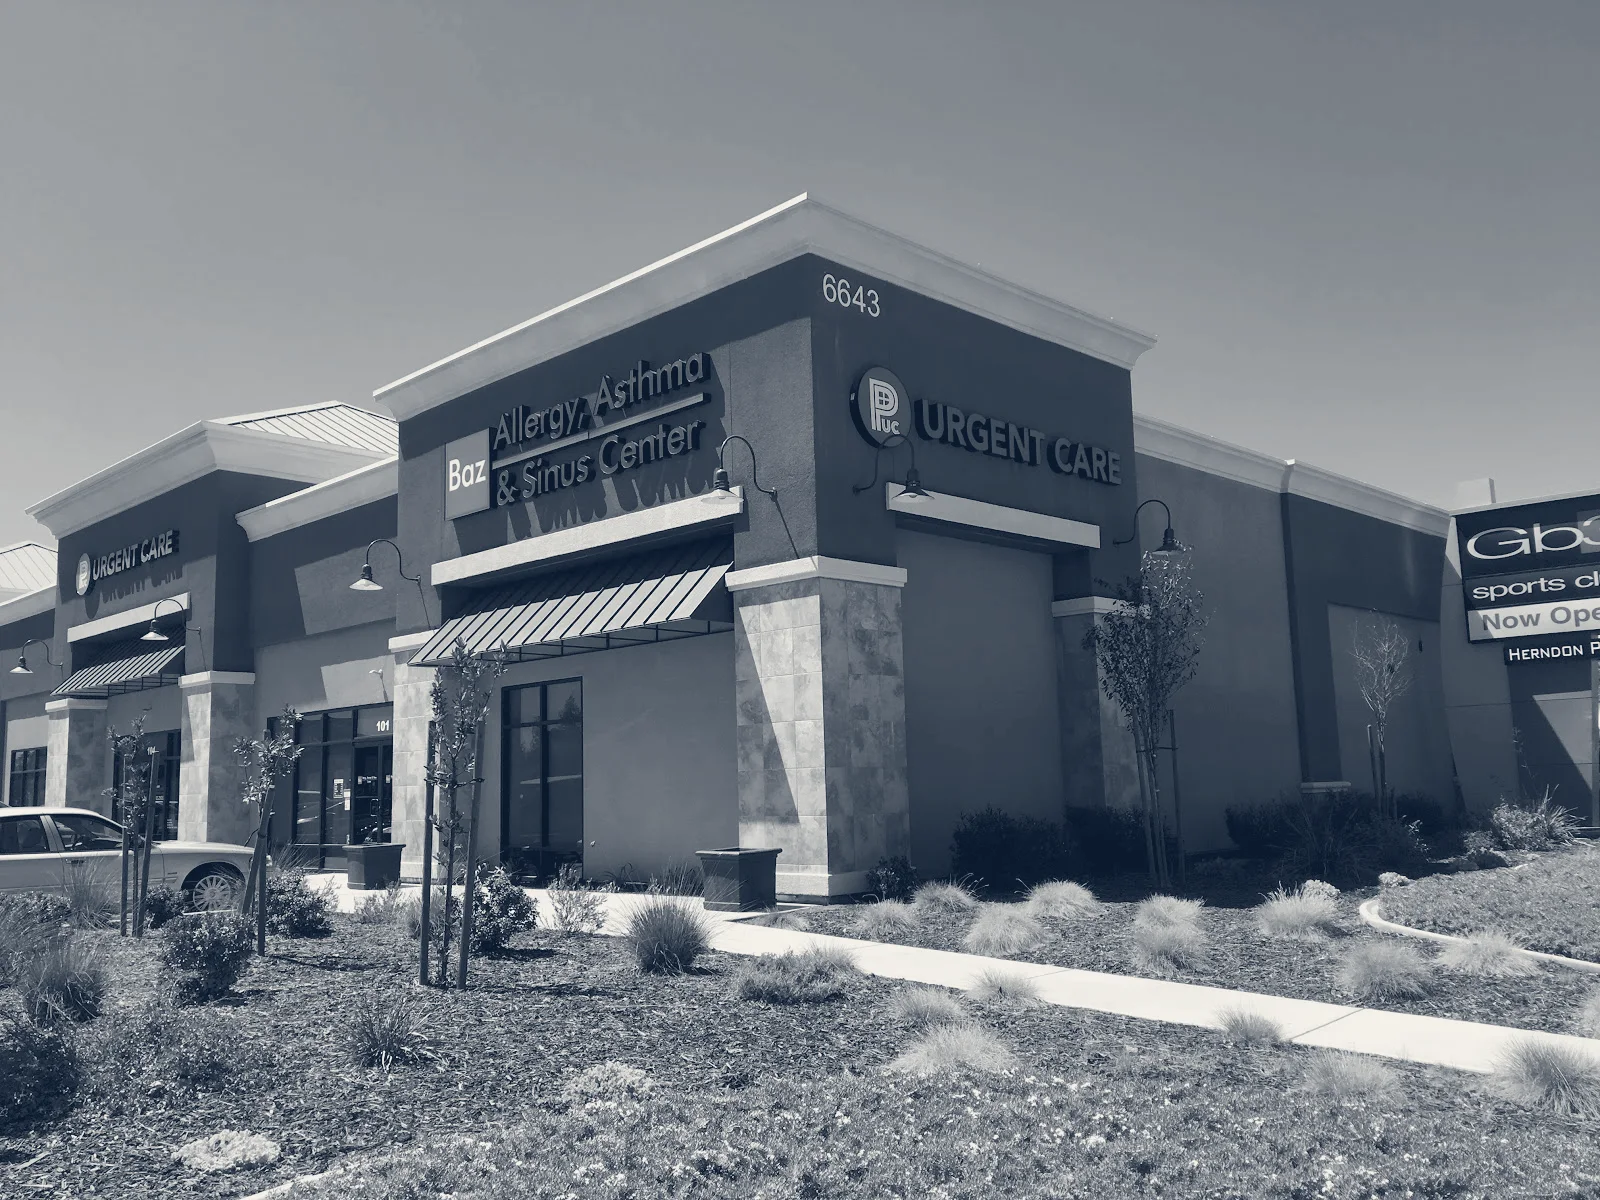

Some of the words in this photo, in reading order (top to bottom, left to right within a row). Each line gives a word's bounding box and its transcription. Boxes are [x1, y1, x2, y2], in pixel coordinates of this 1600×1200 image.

[822, 273, 881, 318] 6643
[493, 397, 584, 450] Allergy,
[594, 352, 704, 416] Asthma
[922, 398, 1046, 466] URGENT
[1054, 437, 1122, 485] CARE
[448, 459, 486, 492] Baz
[497, 470, 522, 506] &
[522, 455, 590, 500] Sinus
[598, 420, 701, 475] Center
[92, 543, 139, 581] URGENT
[140, 529, 173, 563] CARE
[1473, 577, 1567, 602] sports
[1575, 570, 1600, 589] cl
[1482, 612, 1541, 631] Now
[1509, 644, 1584, 661] HERNDON
[376, 720, 390, 732] 101
